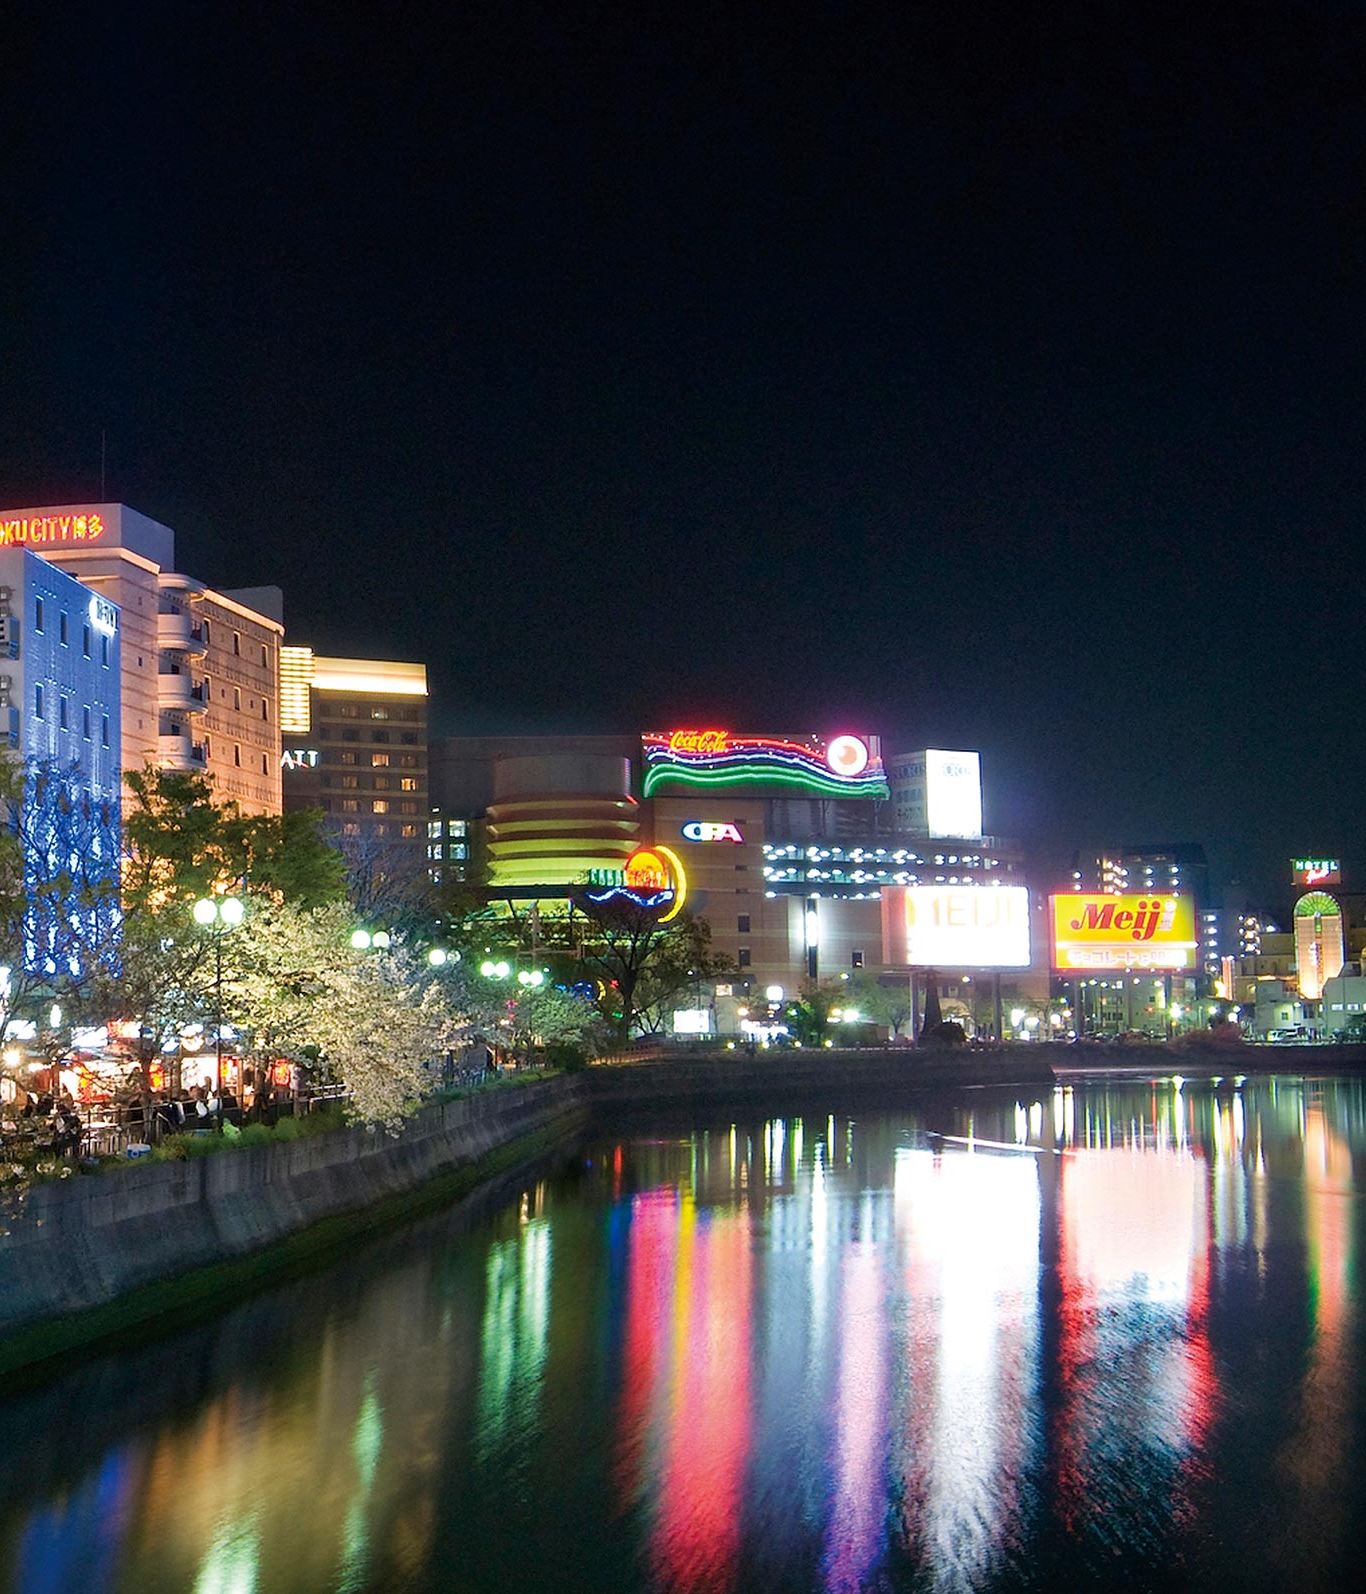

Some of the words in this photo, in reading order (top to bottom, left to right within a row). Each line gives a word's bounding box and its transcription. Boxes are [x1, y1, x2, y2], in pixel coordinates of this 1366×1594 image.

[31, 516, 71, 543] CITY
[74, 515, 103, 540] 博多
[1296, 861, 1338, 870] HOTEL
[1071, 901, 1175, 941] Meiji
